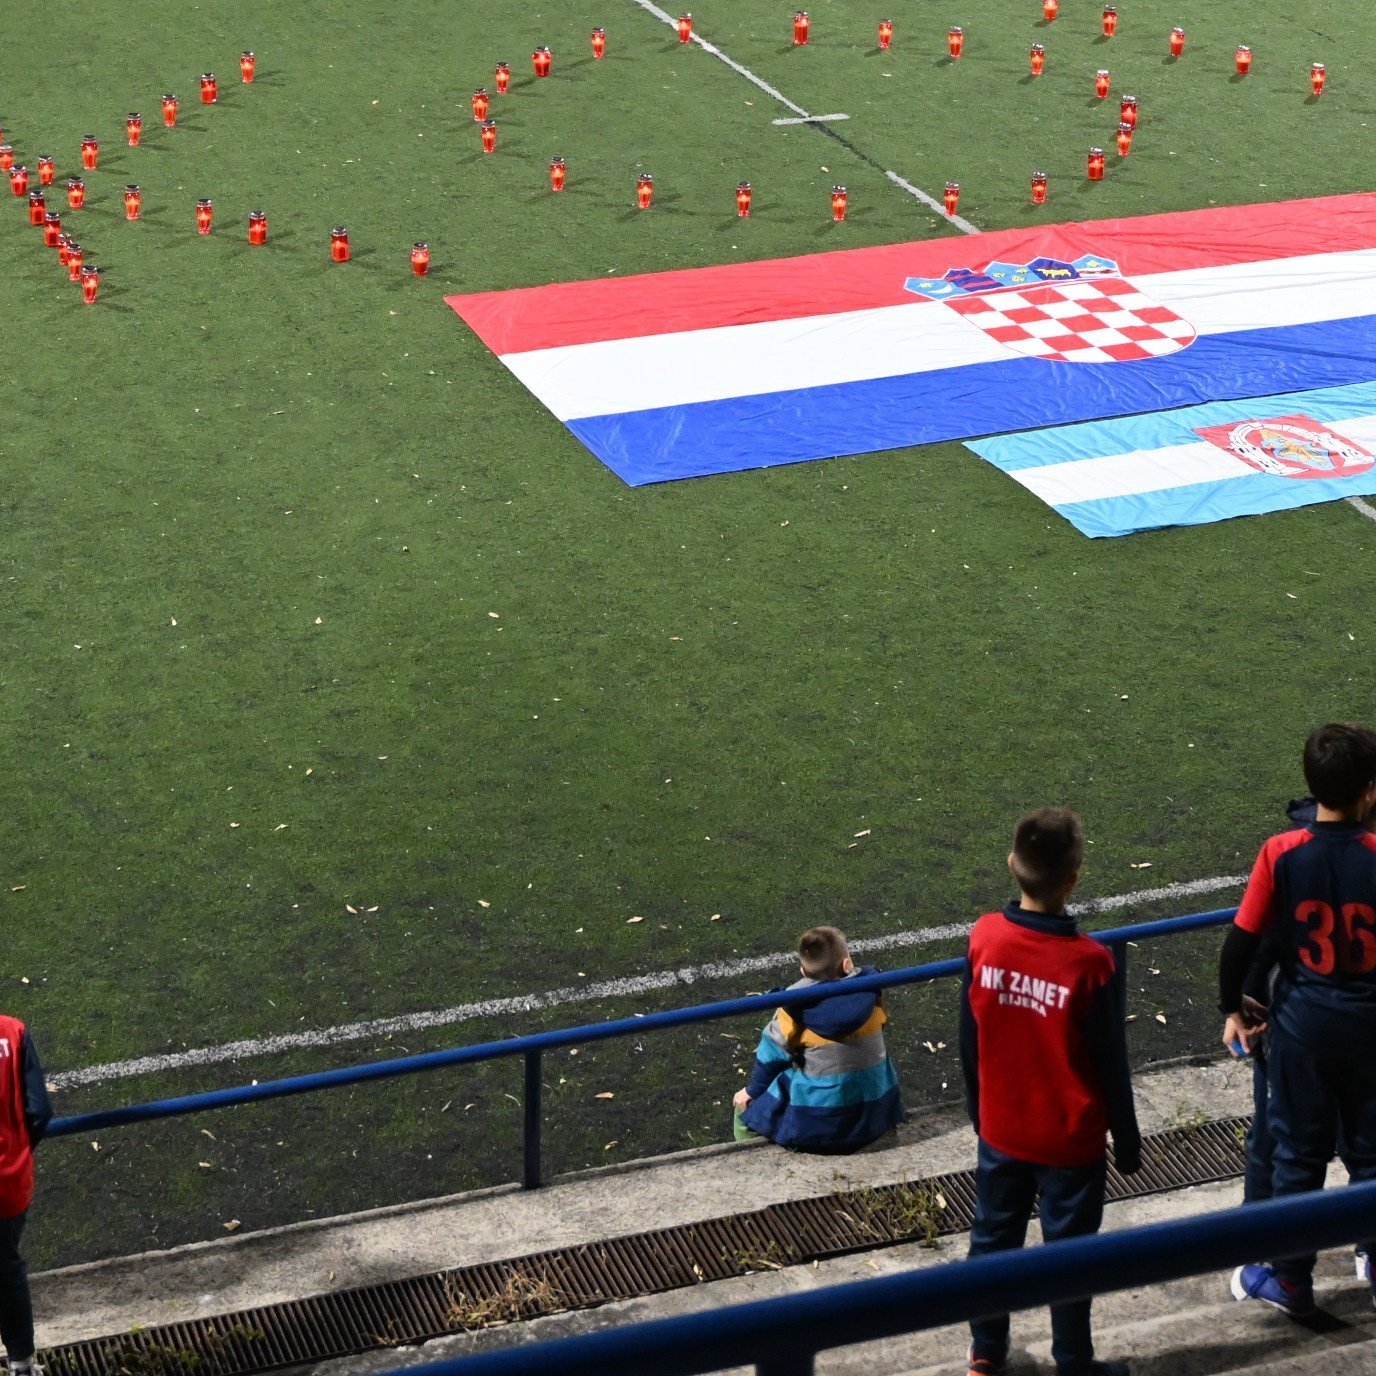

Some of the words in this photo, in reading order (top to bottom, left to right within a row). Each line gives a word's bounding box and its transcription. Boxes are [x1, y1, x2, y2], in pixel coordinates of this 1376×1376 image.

[980, 965, 1005, 990] NK
[1010, 971, 1070, 1009] ZAMET
[998, 993, 1047, 1017] RIJEKA
